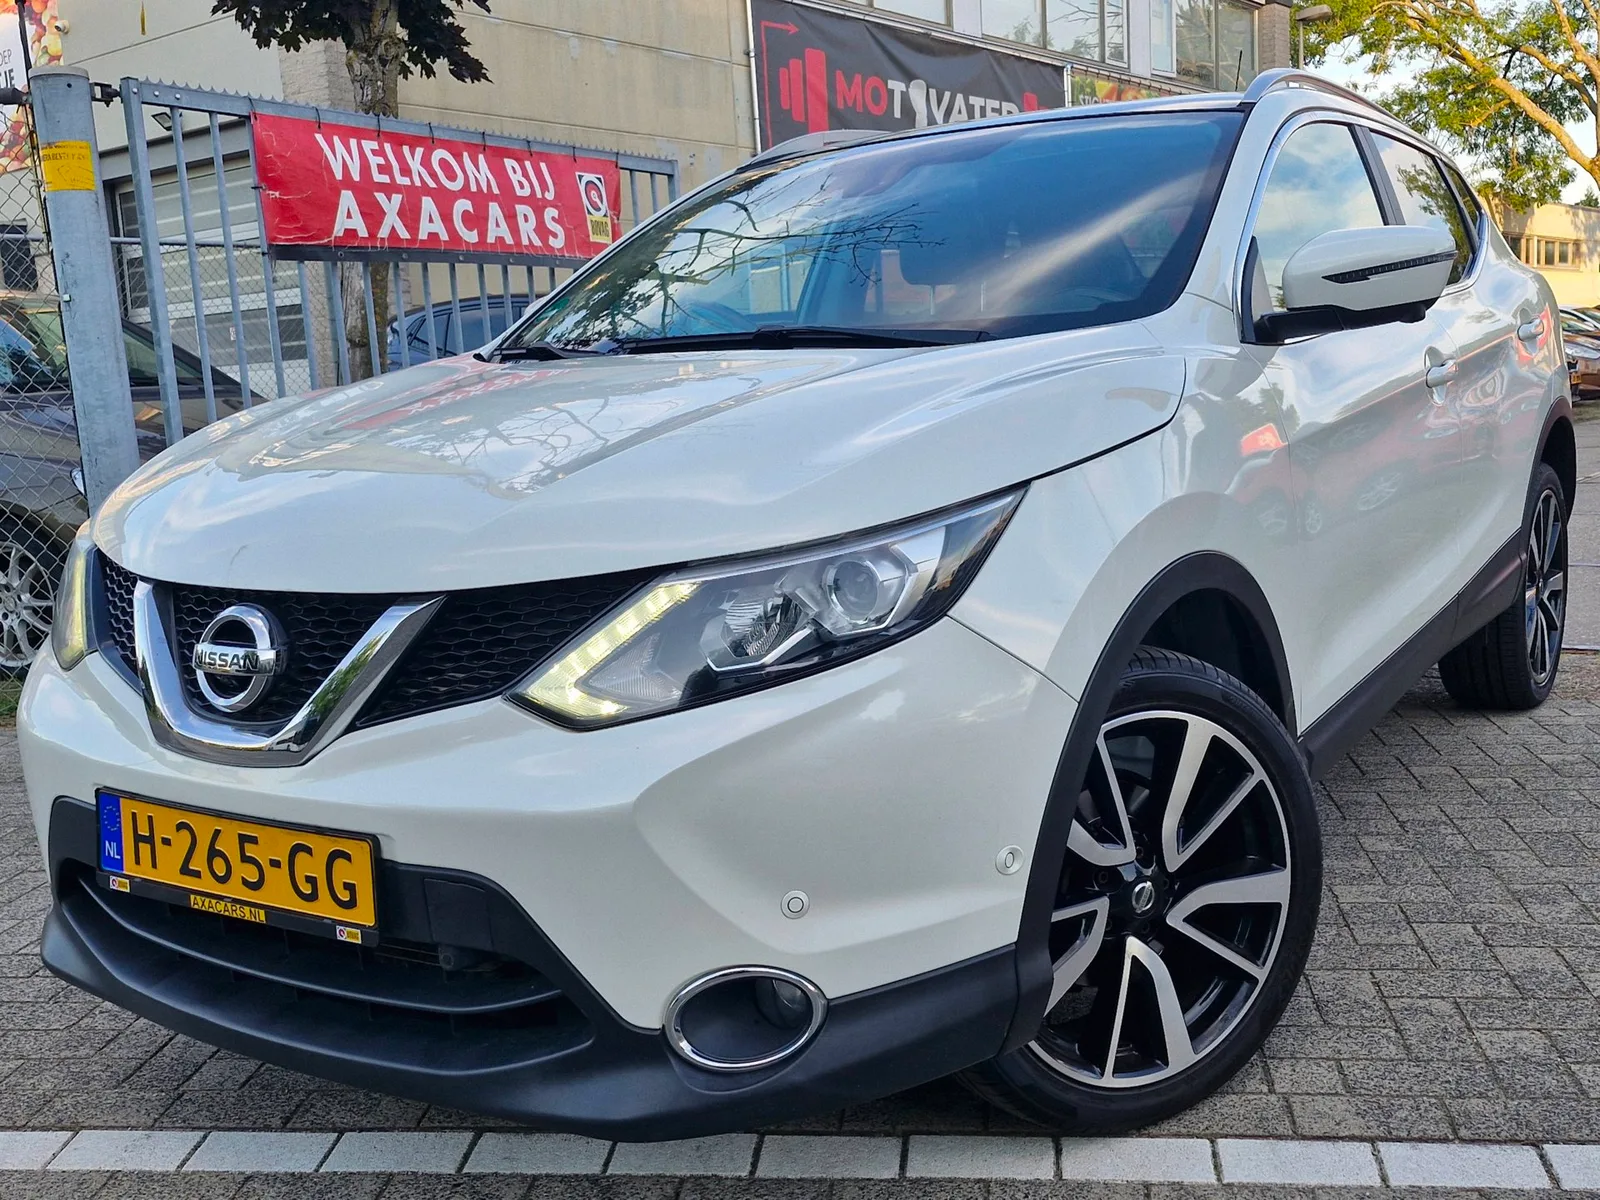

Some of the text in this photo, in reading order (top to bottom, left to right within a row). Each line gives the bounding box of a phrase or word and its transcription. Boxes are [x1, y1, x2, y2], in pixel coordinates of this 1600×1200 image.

[314, 133, 556, 201] WELKOM BIJ
[334, 190, 566, 249] AXACARS
[196, 648, 260, 671] NISSAN
[104, 840, 121, 860] NL
[131, 810, 359, 910] H-265-GG
[192, 895, 265, 923] AXACARS.NL
